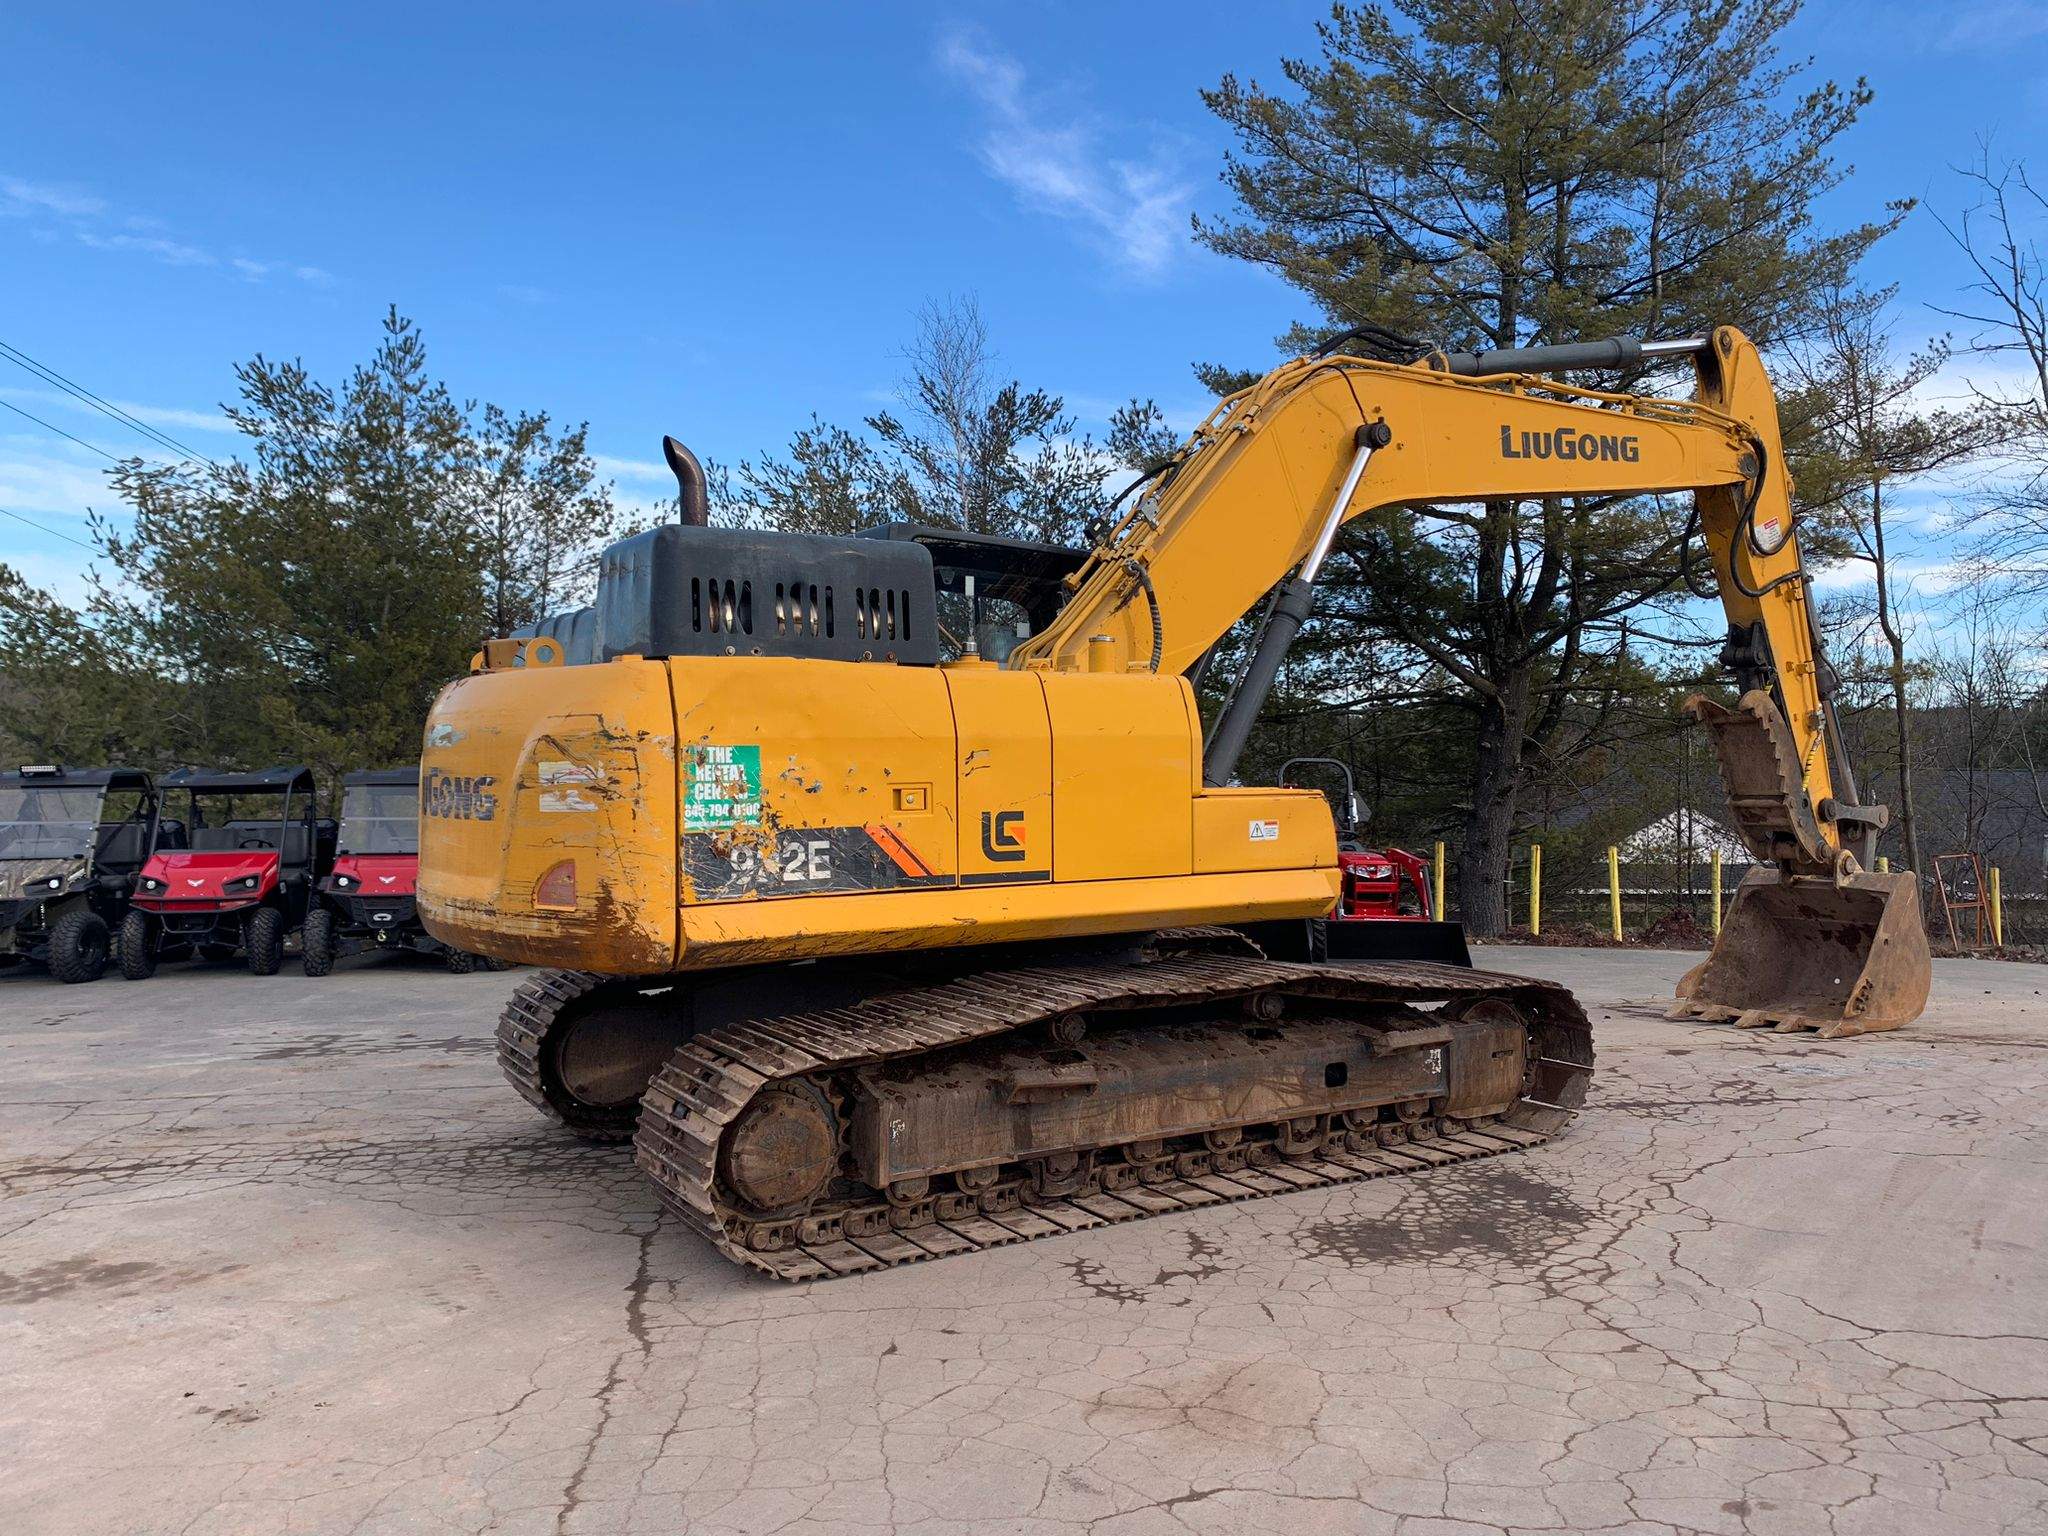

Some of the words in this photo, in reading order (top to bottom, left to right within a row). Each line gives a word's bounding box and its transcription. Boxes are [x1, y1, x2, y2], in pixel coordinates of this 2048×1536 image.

[706, 747, 733, 764] THE
[695, 783, 749, 800] CEN
[730, 840, 831, 885] 92E
